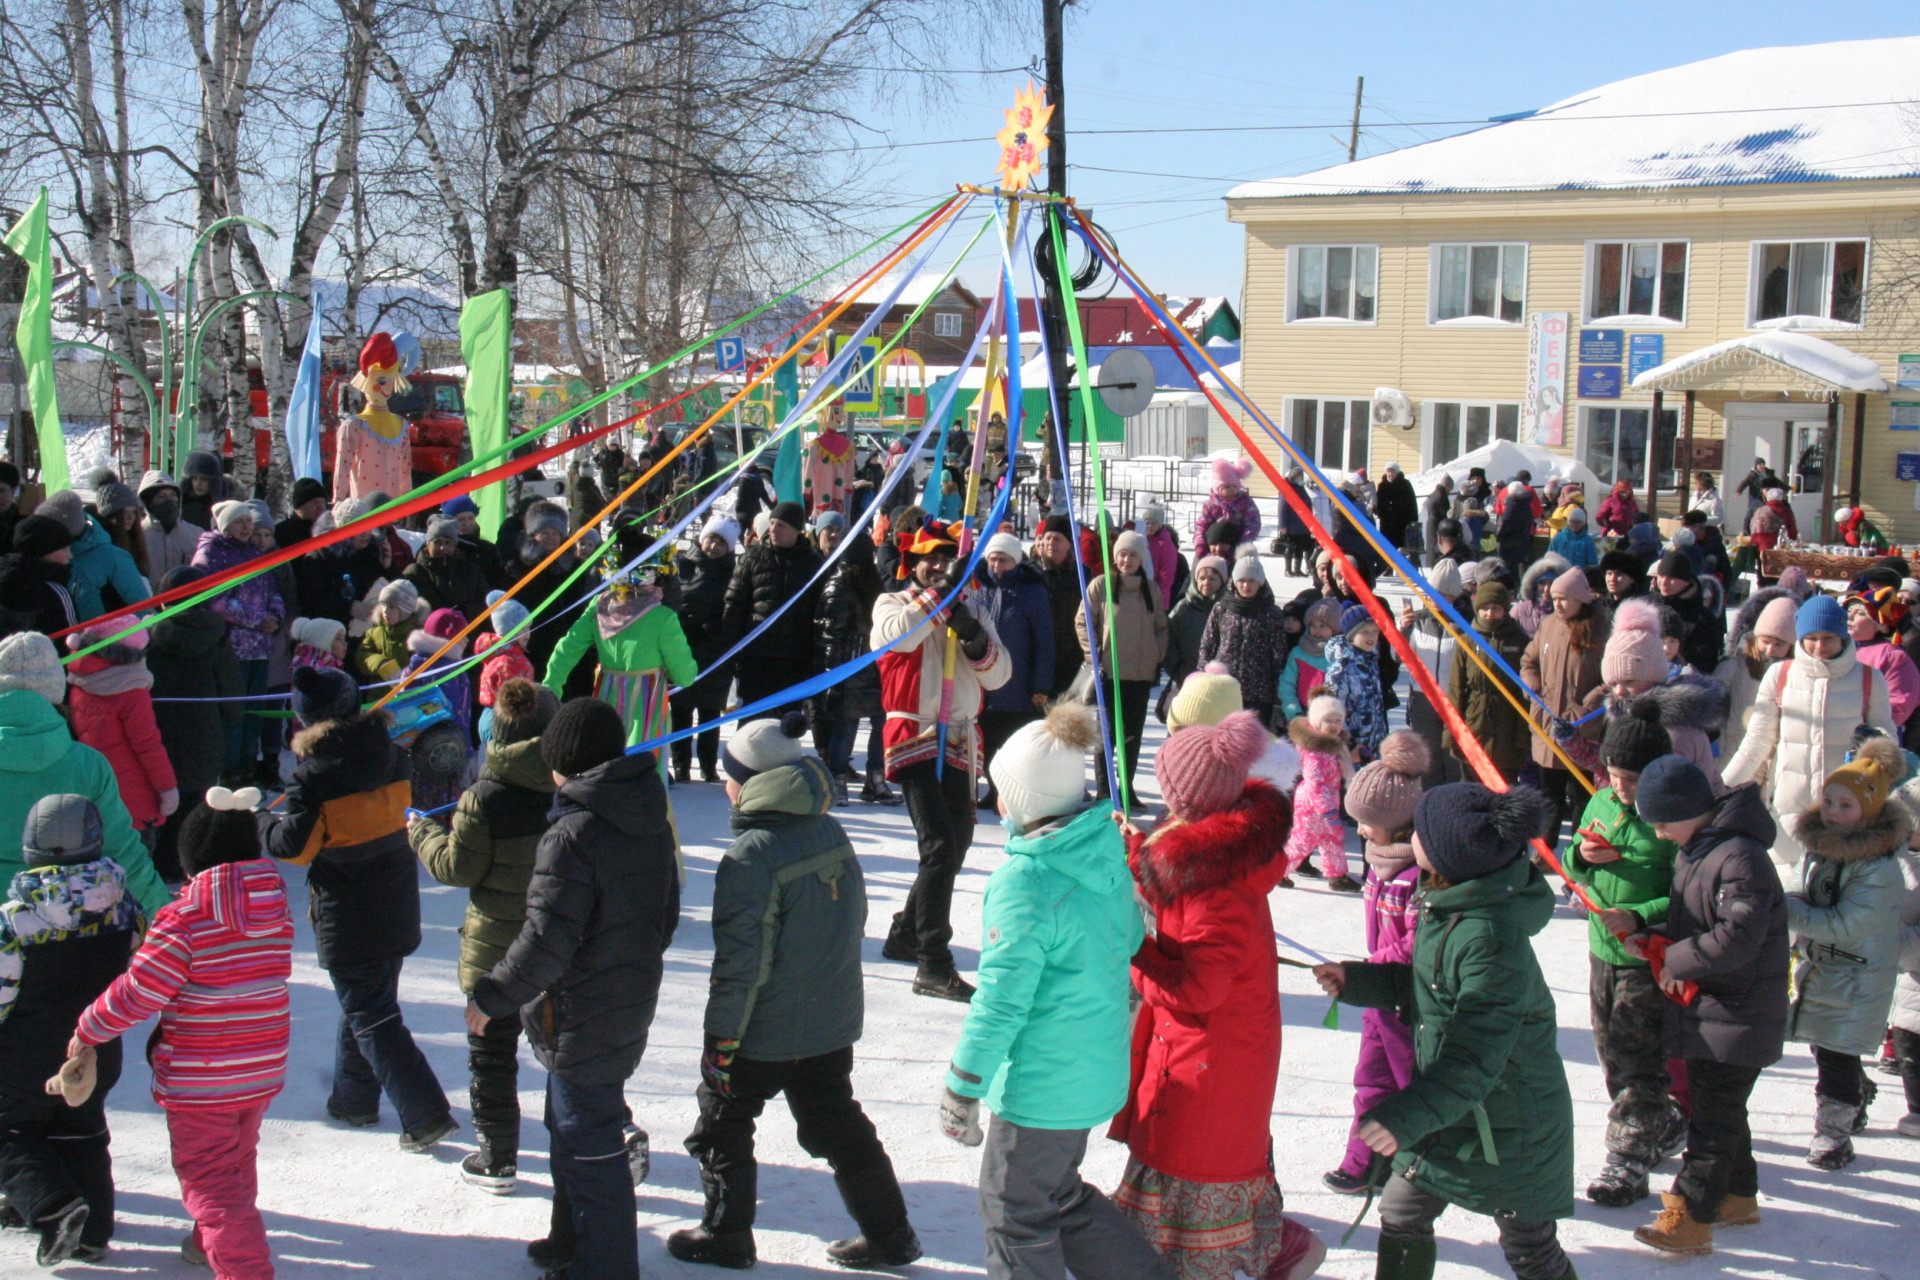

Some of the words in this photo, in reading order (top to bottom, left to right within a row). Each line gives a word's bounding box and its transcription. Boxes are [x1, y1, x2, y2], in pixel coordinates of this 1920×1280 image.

[721, 341, 737, 369] P
[1530, 315, 1538, 354] САЛОН
[1543, 317, 1565, 380] ФЕЯ
[1527, 359, 1537, 416] КРАСОТЫ
